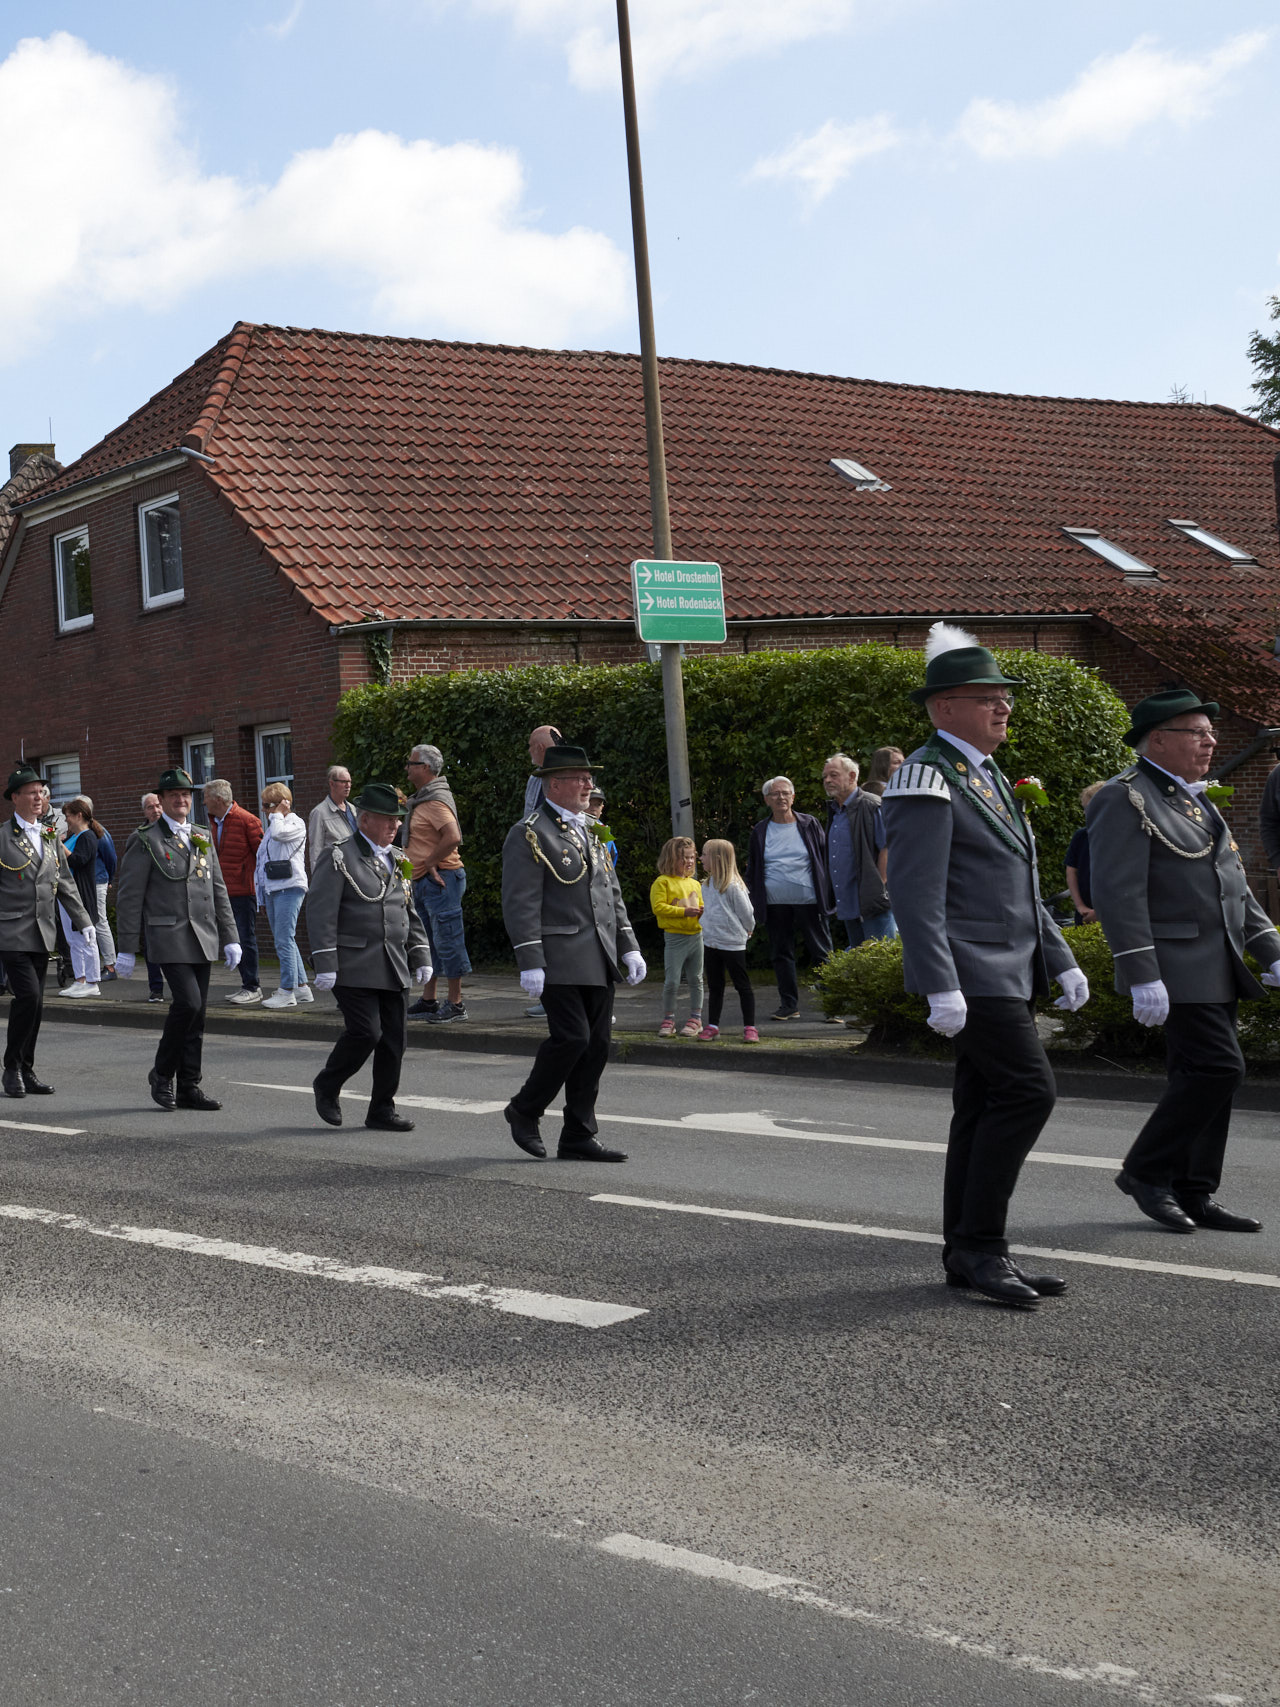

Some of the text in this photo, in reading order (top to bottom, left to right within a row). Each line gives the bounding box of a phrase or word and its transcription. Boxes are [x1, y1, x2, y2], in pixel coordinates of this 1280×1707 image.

[654, 569, 718, 583] Hotel Drostenhof
[657, 596, 722, 610] Hotel Rodenbäck
